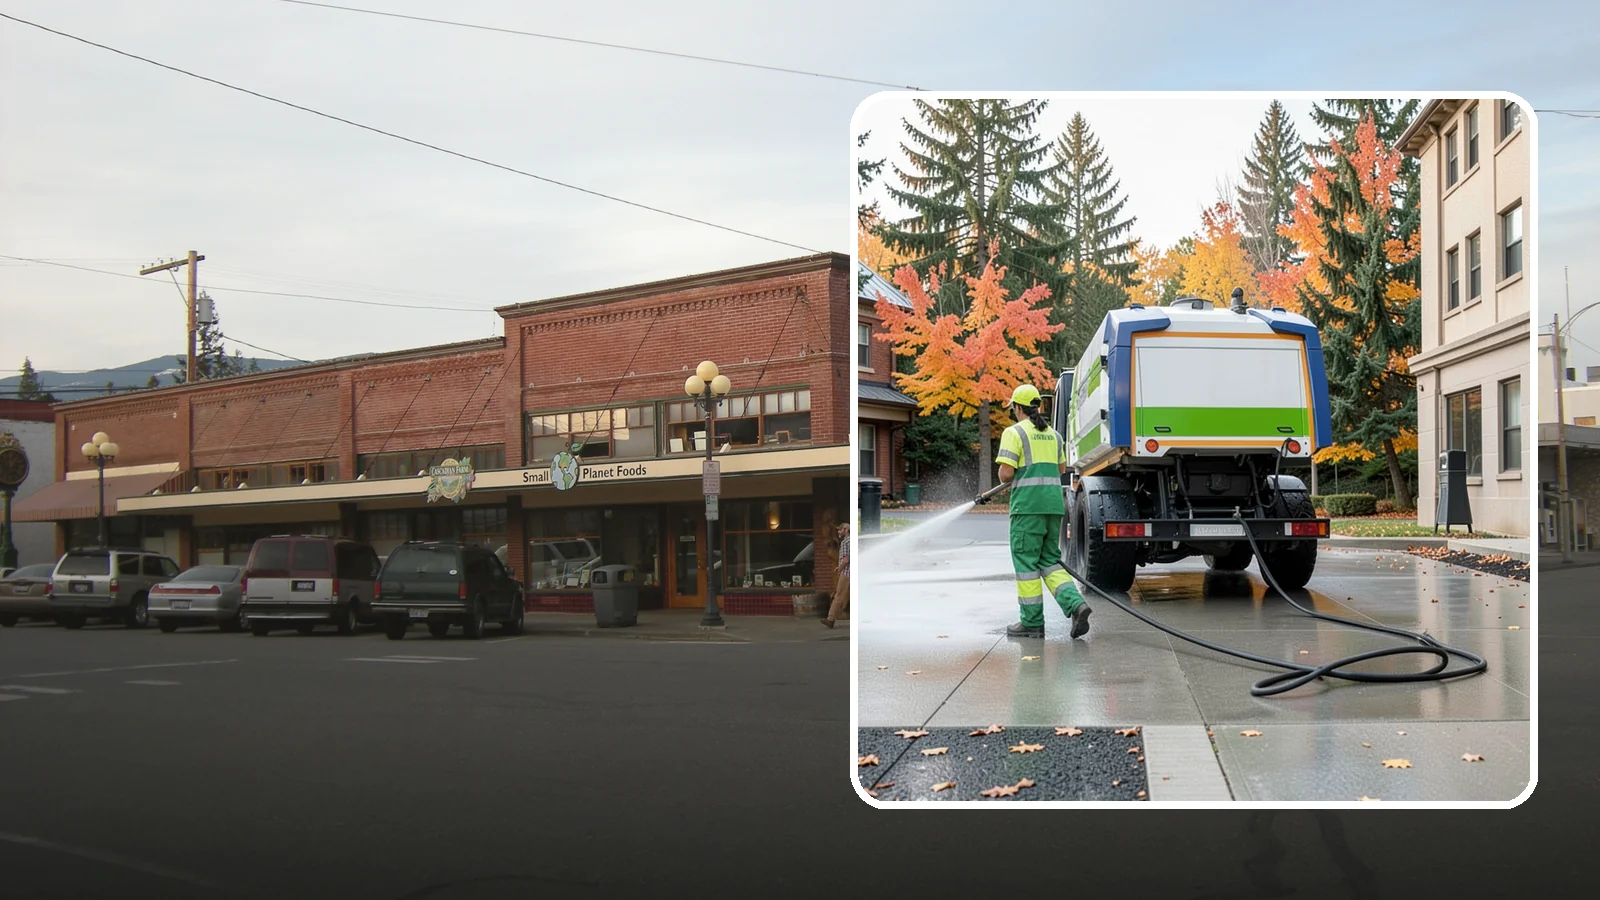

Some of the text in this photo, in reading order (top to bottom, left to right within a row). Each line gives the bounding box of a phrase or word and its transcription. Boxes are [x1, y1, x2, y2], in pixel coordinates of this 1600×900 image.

[523, 464, 647, 483] Small Planet Foods
